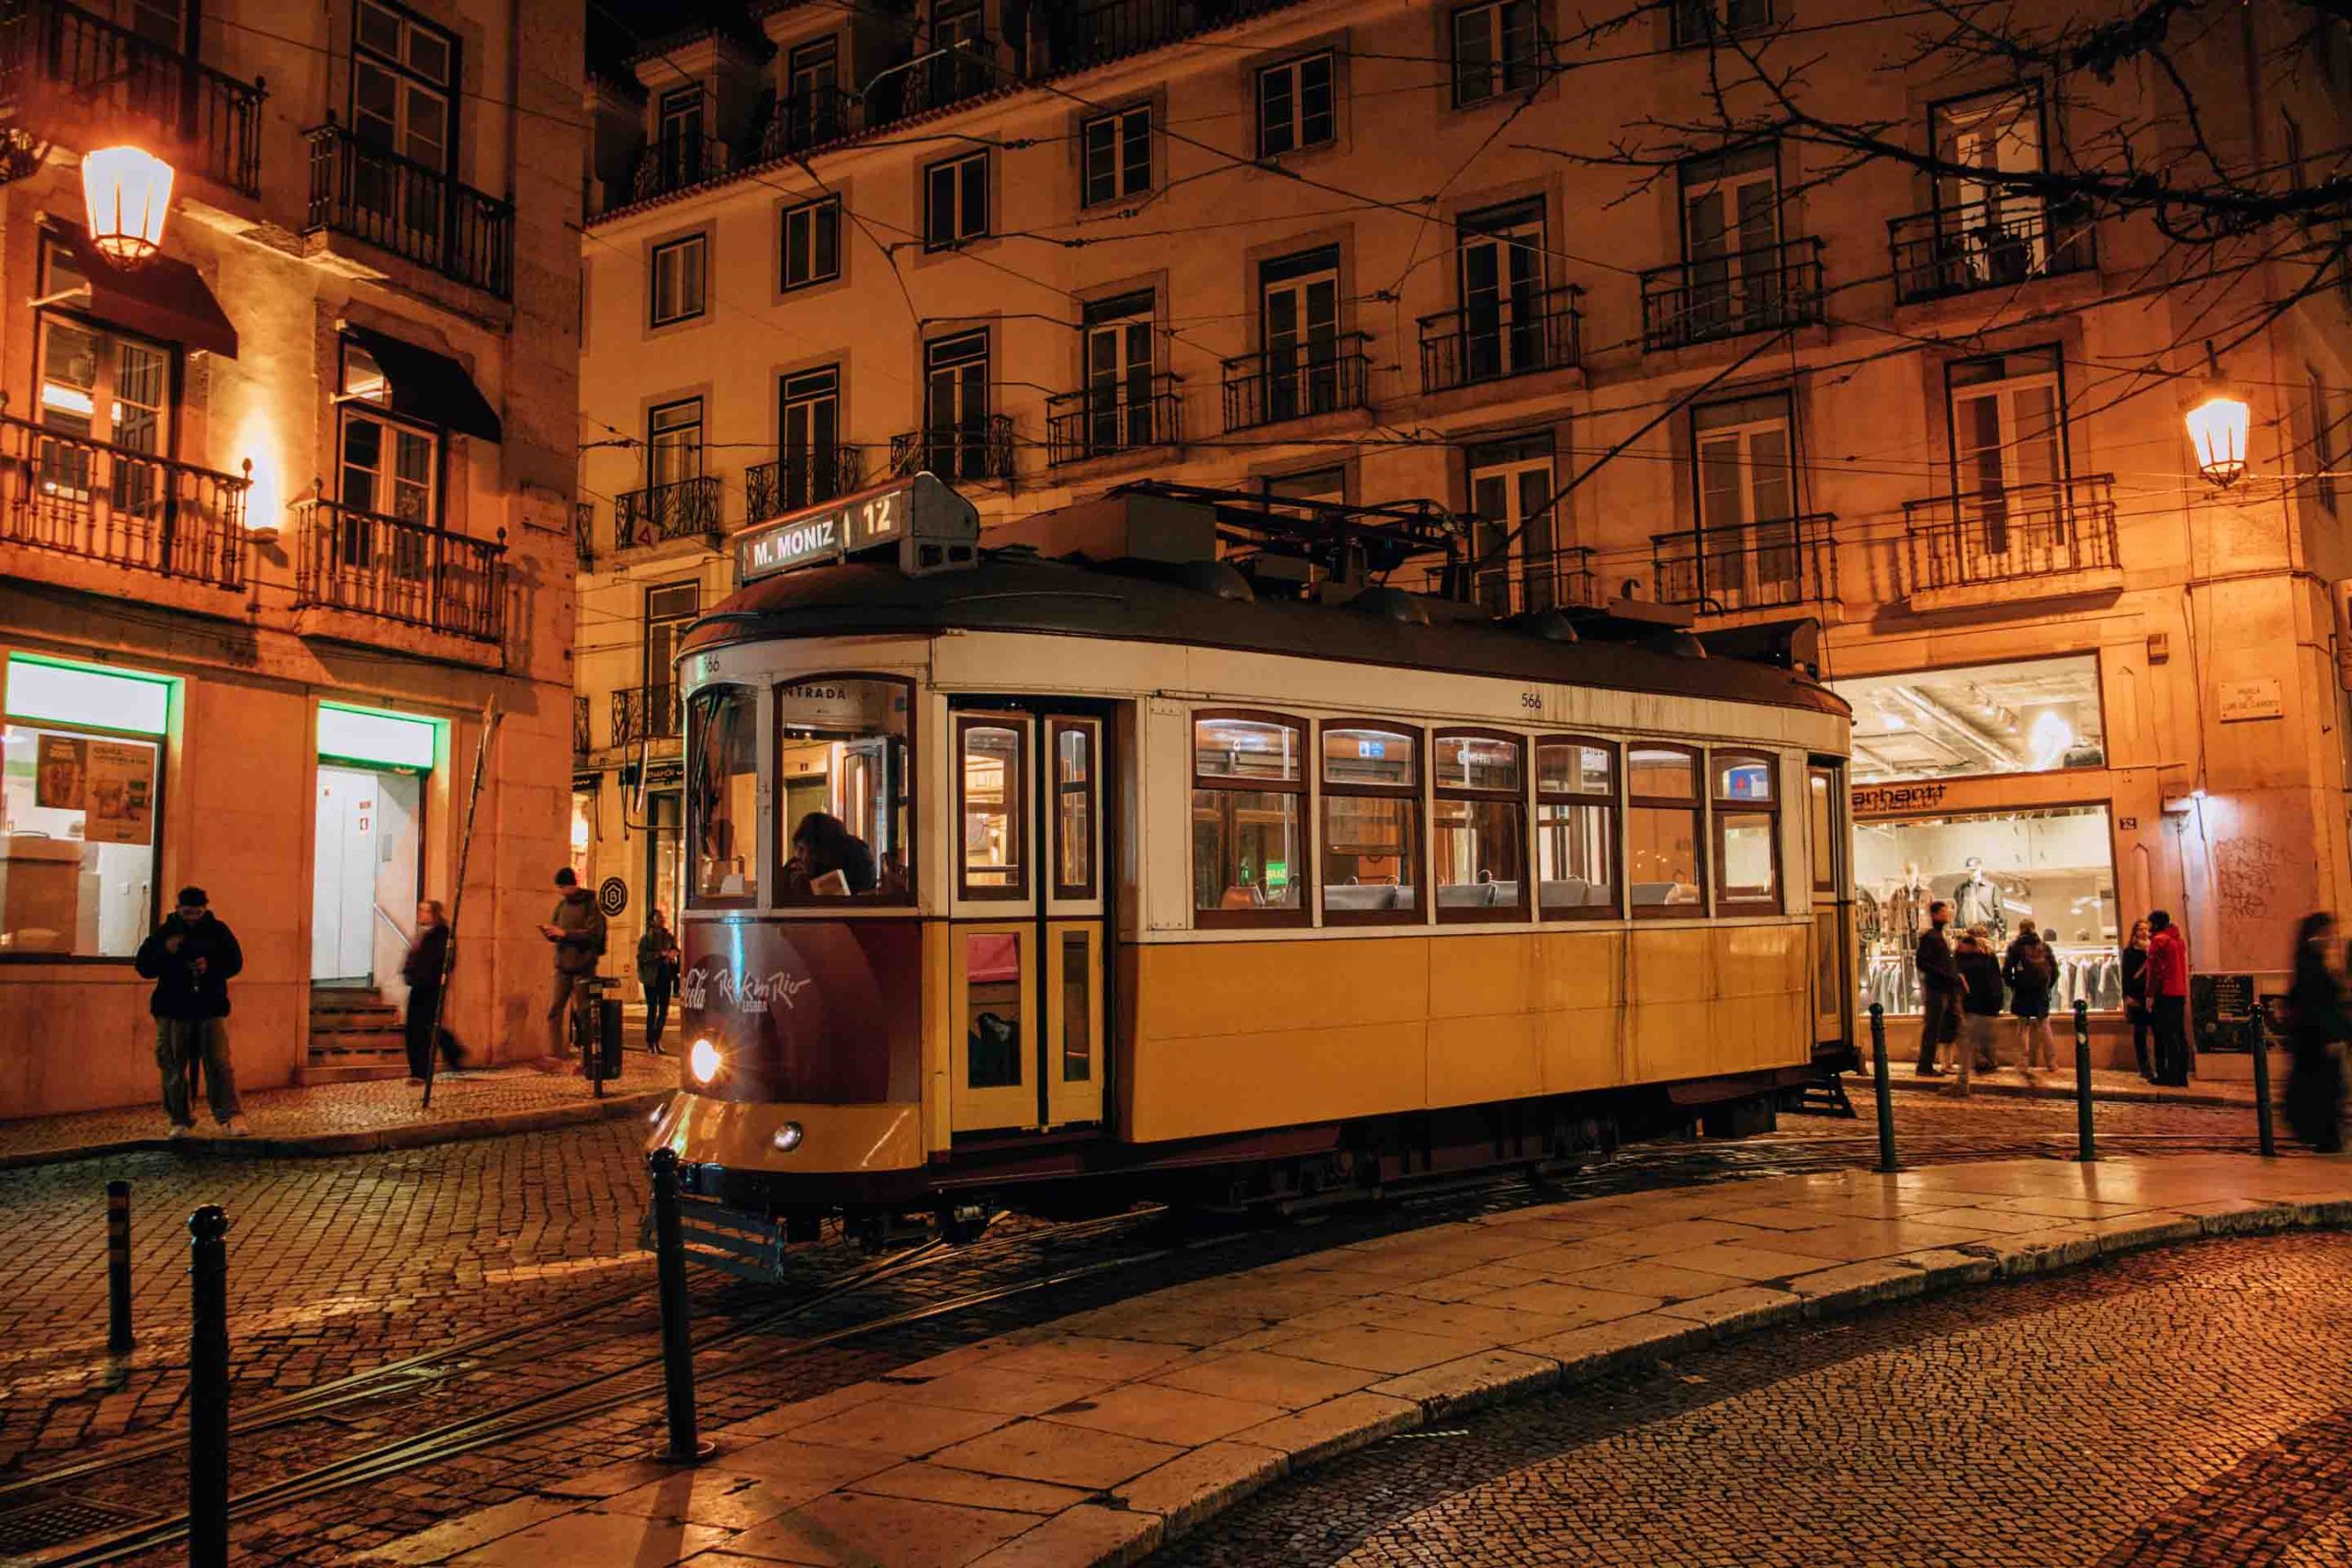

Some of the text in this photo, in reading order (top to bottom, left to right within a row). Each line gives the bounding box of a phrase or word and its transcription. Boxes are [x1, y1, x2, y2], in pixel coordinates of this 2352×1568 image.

[863, 499, 891, 536] 12
[753, 520, 835, 568] M. MONIZ
[784, 686, 846, 700] NTRADA
[1521, 693, 1542, 708] 566
[1851, 784, 1947, 807] arhartt
[713, 968, 754, 1005] Rok
[768, 971, 811, 1010] Rio
